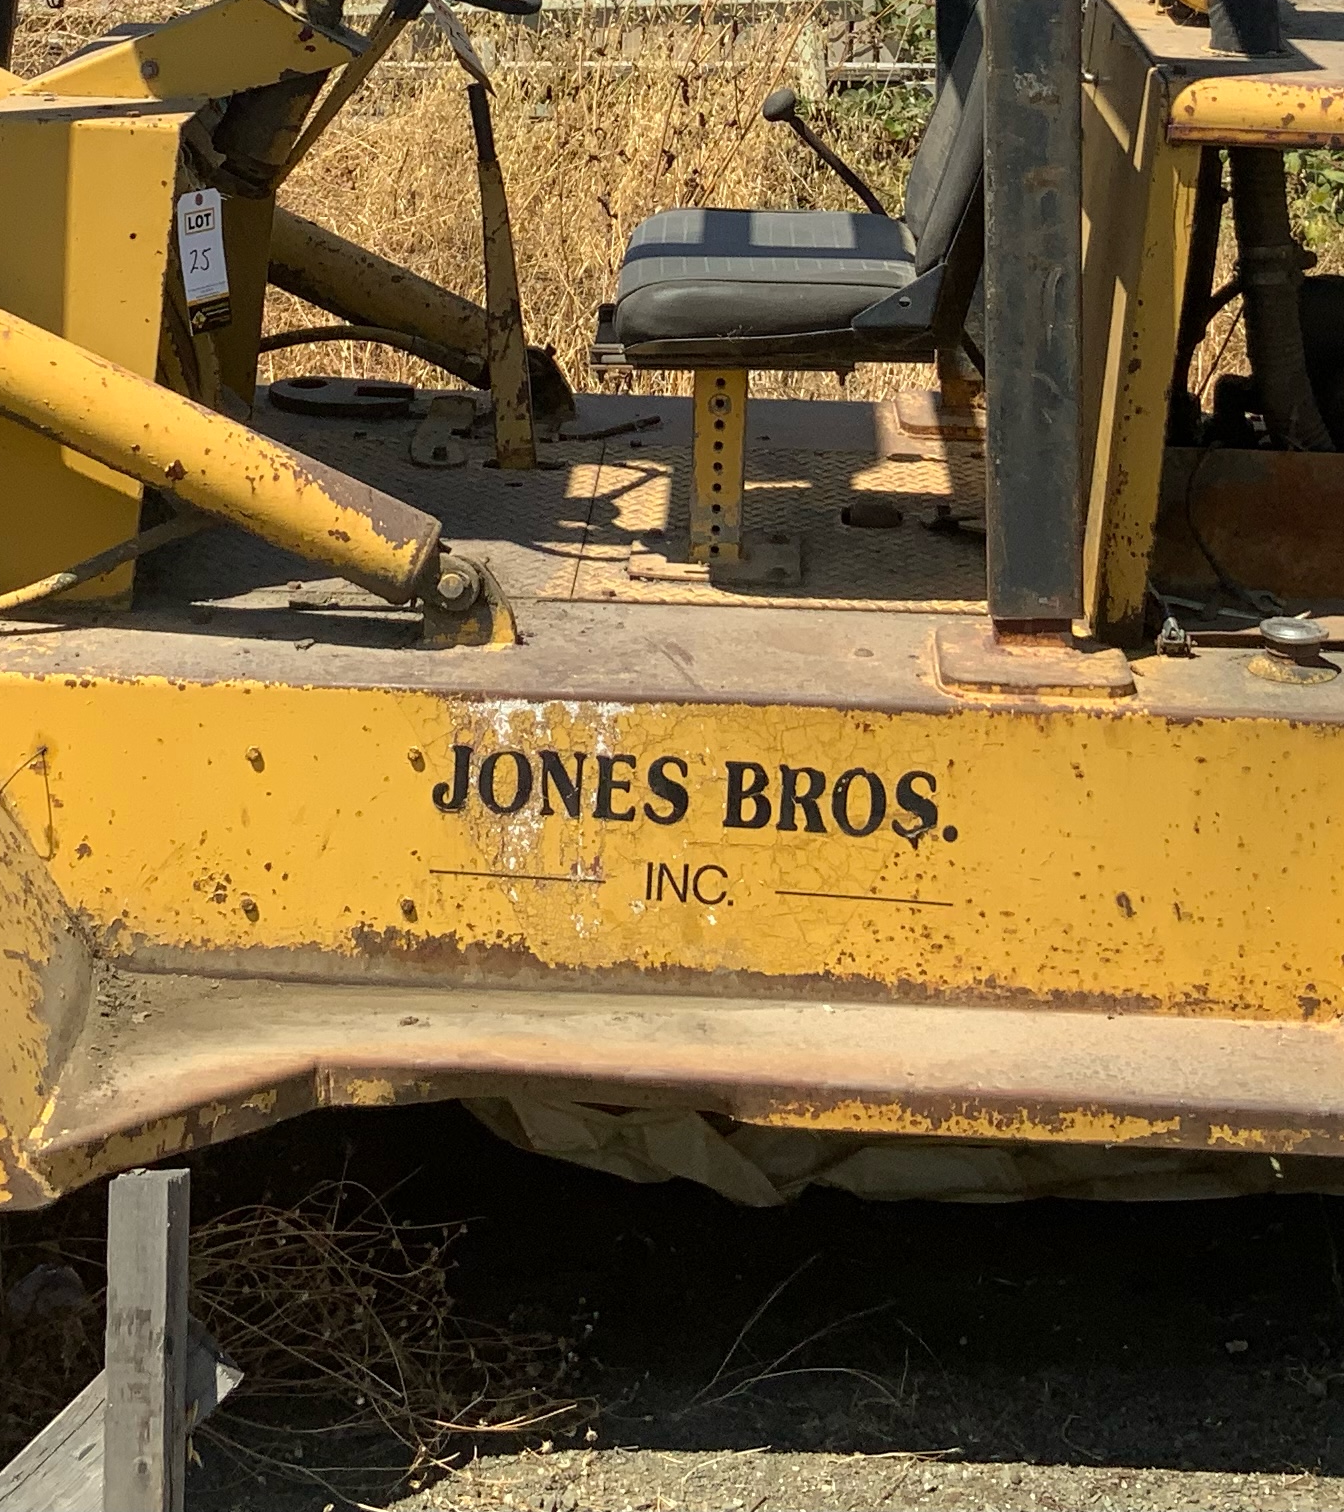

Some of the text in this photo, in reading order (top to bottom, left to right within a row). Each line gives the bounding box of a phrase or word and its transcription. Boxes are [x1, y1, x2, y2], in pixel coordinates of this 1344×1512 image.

[188, 213, 212, 230] LOT
[190, 247, 212, 274] 25
[431, 745, 960, 844] JONES BROS.
[644, 862, 735, 906] INC.
